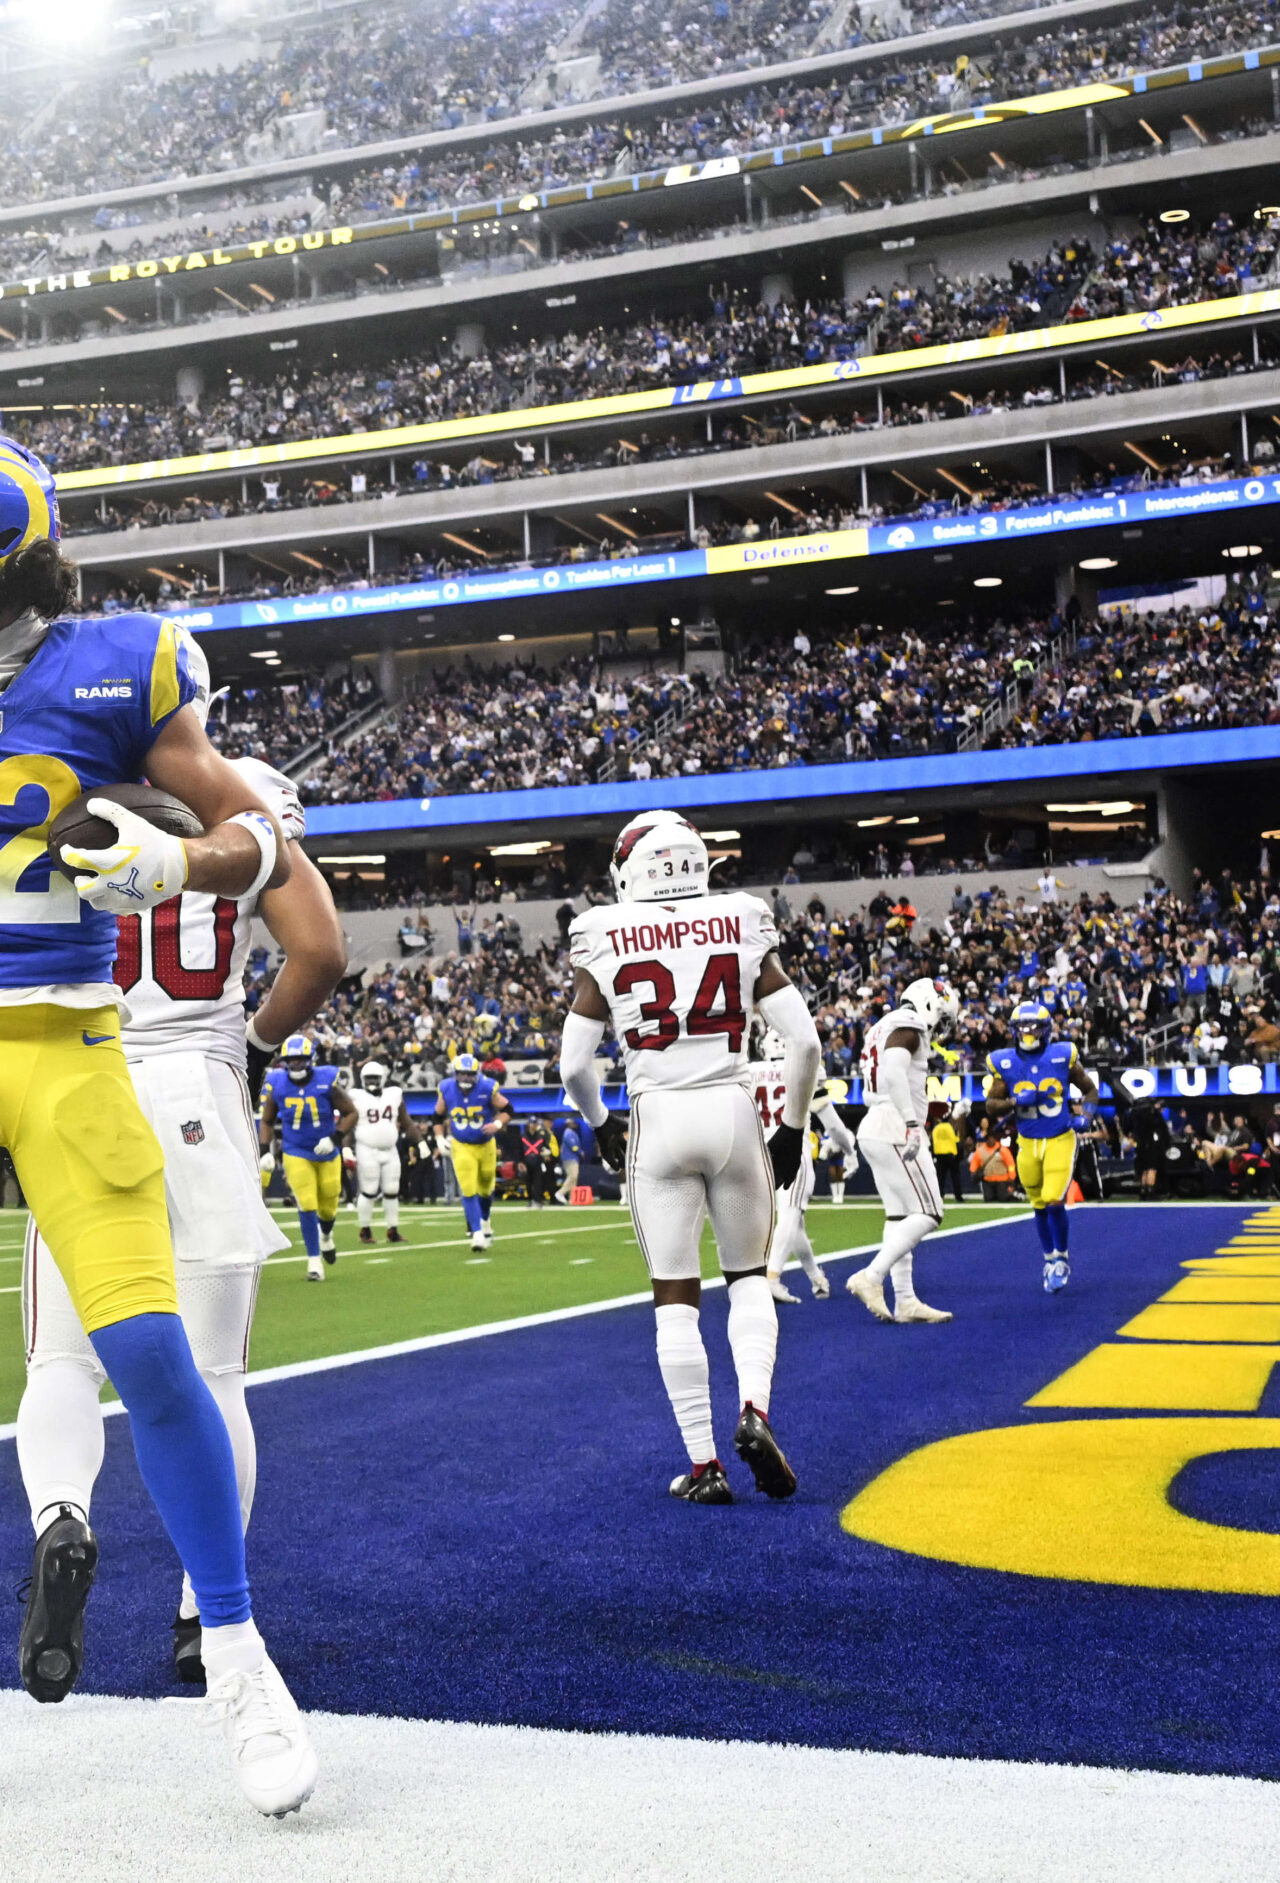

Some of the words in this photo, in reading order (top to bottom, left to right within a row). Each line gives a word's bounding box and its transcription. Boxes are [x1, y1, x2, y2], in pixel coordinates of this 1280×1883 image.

[22, 270, 91, 296] THE
[110, 249, 232, 282] ROYAL
[248, 226, 353, 258] TOUR
[980, 516, 998, 536] 3
[1006, 513, 1052, 531] Forced
[1053, 505, 1114, 524] Fumbles:
[1118, 499, 1126, 517] 1
[1146, 490, 1239, 512] Interceptions:
[1244, 481, 1264, 500] 0
[744, 542, 830, 562] Defense
[331, 596, 348, 612] 0
[443, 582, 460, 599] 0
[543, 571, 560, 588] 0
[668, 557, 676, 573] 1
[75, 686, 132, 699] RAMS
[654, 888, 670, 896] END
[671, 885, 698, 894] RACISM
[113, 893, 238, 1000] 0
[606, 916, 741, 957] THOMPSON
[613, 953, 746, 1053] 34
[284, 1096, 321, 1130] 71
[367, 1105, 393, 1124] 94
[185, 1129, 203, 1143] NFL
[574, 1189, 587, 1203] 10
